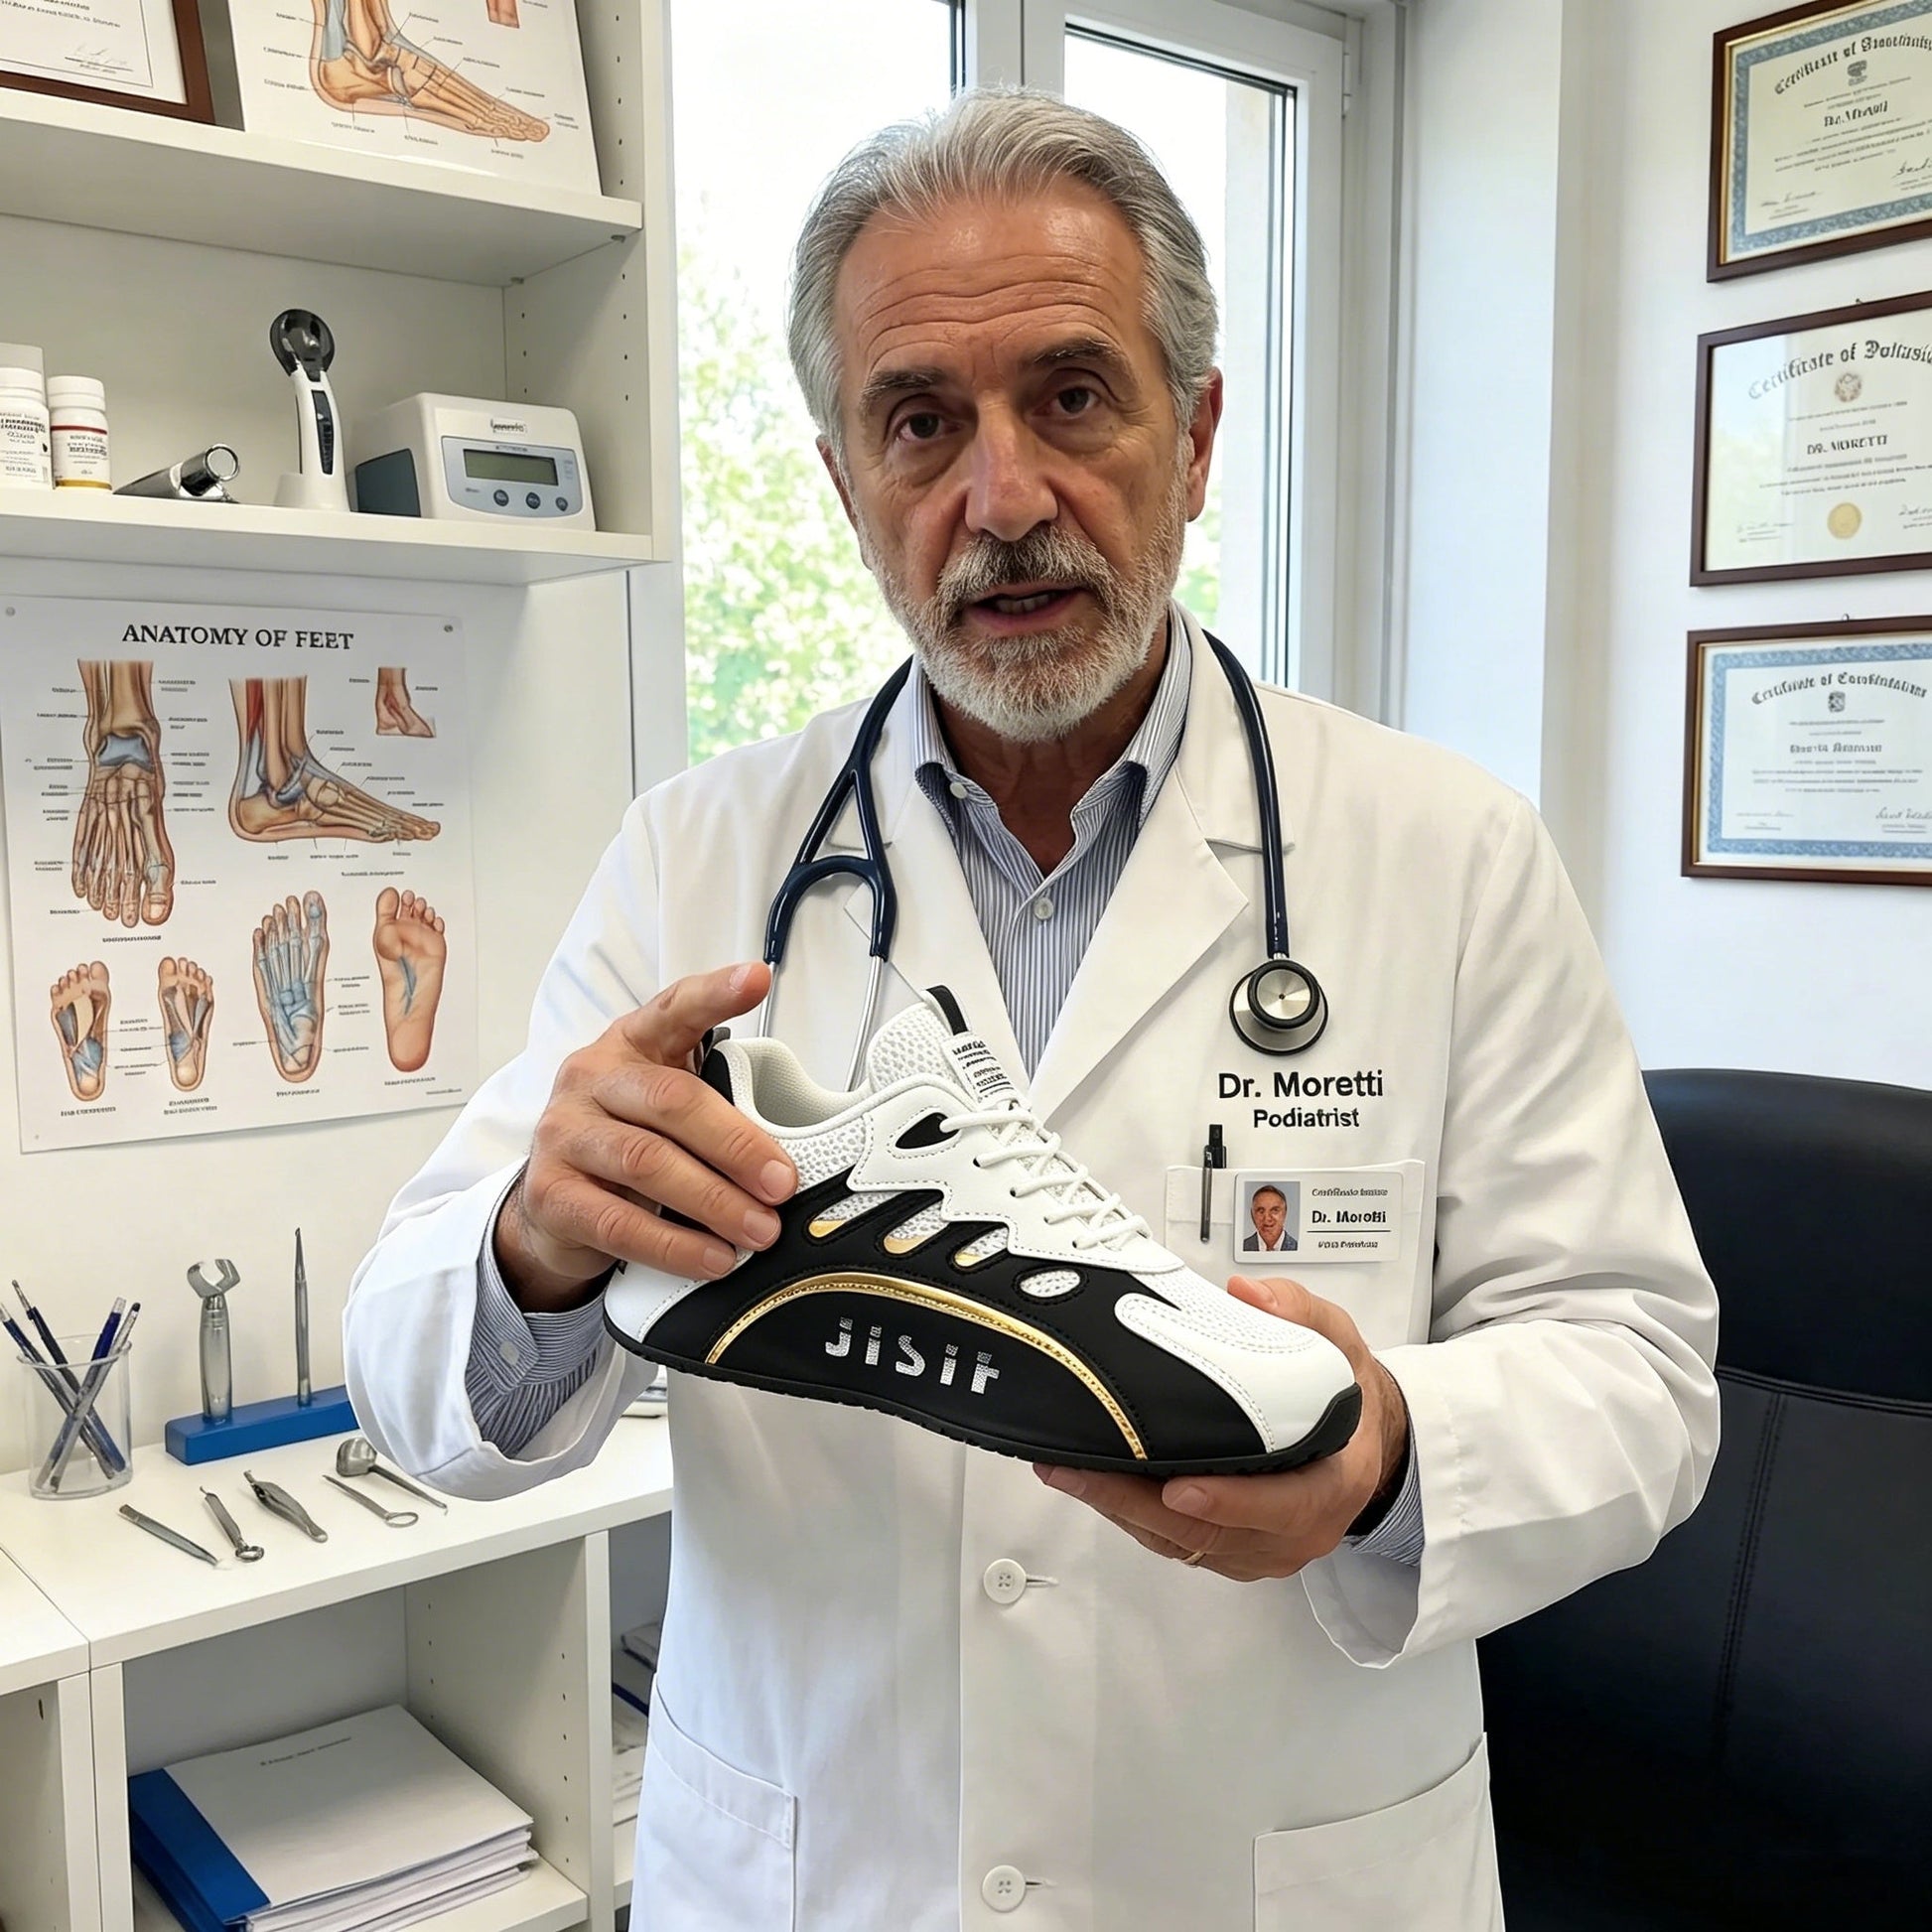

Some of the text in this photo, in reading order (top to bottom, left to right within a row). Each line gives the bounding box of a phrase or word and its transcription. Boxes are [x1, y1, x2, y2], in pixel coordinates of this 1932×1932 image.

[1840, 342, 1858, 362] of
[121, 623, 354, 650] ANATOMY OF FEET
[1218, 1069, 1384, 1099] Dr. Moretti
[1253, 1107, 1360, 1129] Podiatrist
[1311, 1210, 1331, 1224] Dr.
